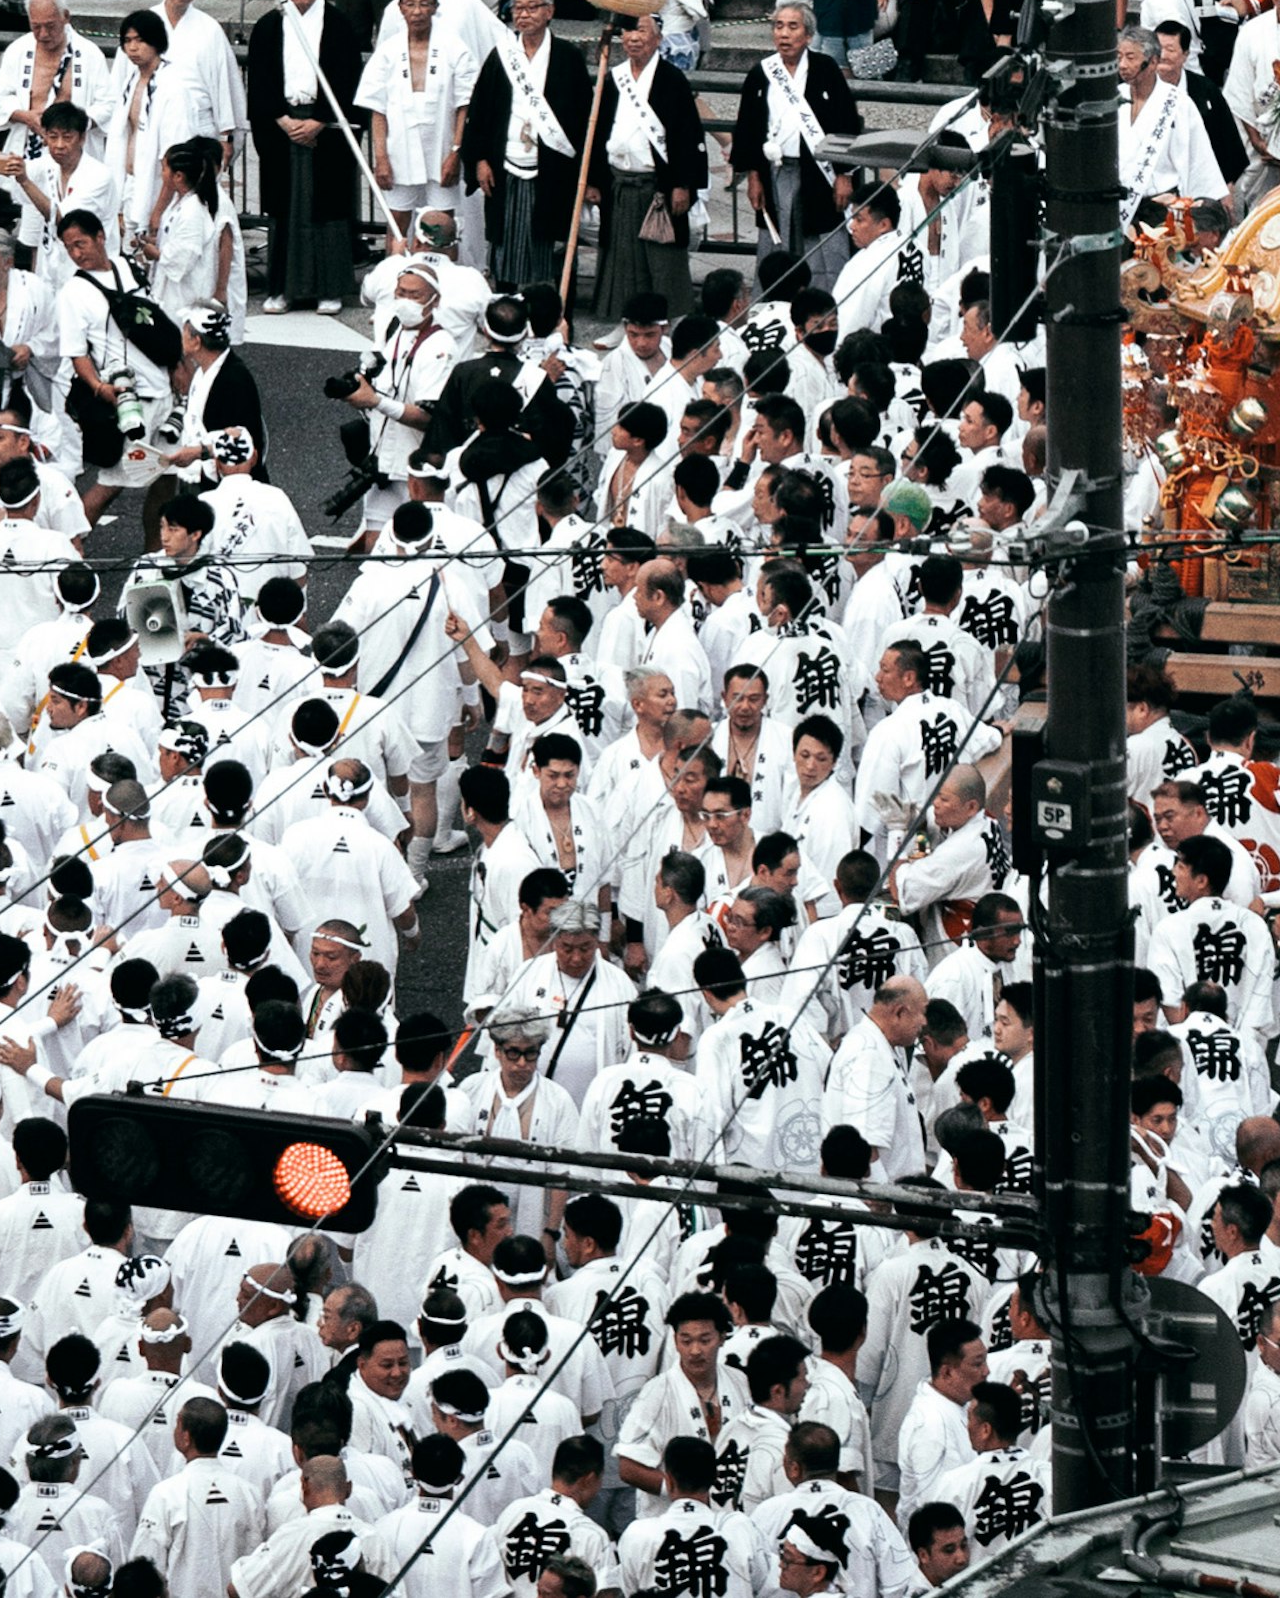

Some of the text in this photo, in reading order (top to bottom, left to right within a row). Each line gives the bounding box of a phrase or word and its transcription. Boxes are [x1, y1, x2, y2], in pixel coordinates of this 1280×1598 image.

[961, 589, 1019, 652] 錦
[795, 647, 841, 714] 錦
[921, 712, 957, 779] 錦
[1043, 807, 1065, 824] 5P
[1199, 764, 1251, 828] 錦
[841, 928, 899, 990] 錦
[1194, 921, 1246, 988] 錦
[741, 1021, 798, 1099] 錦
[1185, 1027, 1240, 1083] 錦
[796, 1222, 857, 1285] 錦
[592, 1286, 651, 1359] 錦
[910, 1262, 971, 1335] 錦
[973, 1471, 1044, 1547] 錦
[506, 1513, 570, 1577] 錦
[655, 1525, 729, 1598] 錦
